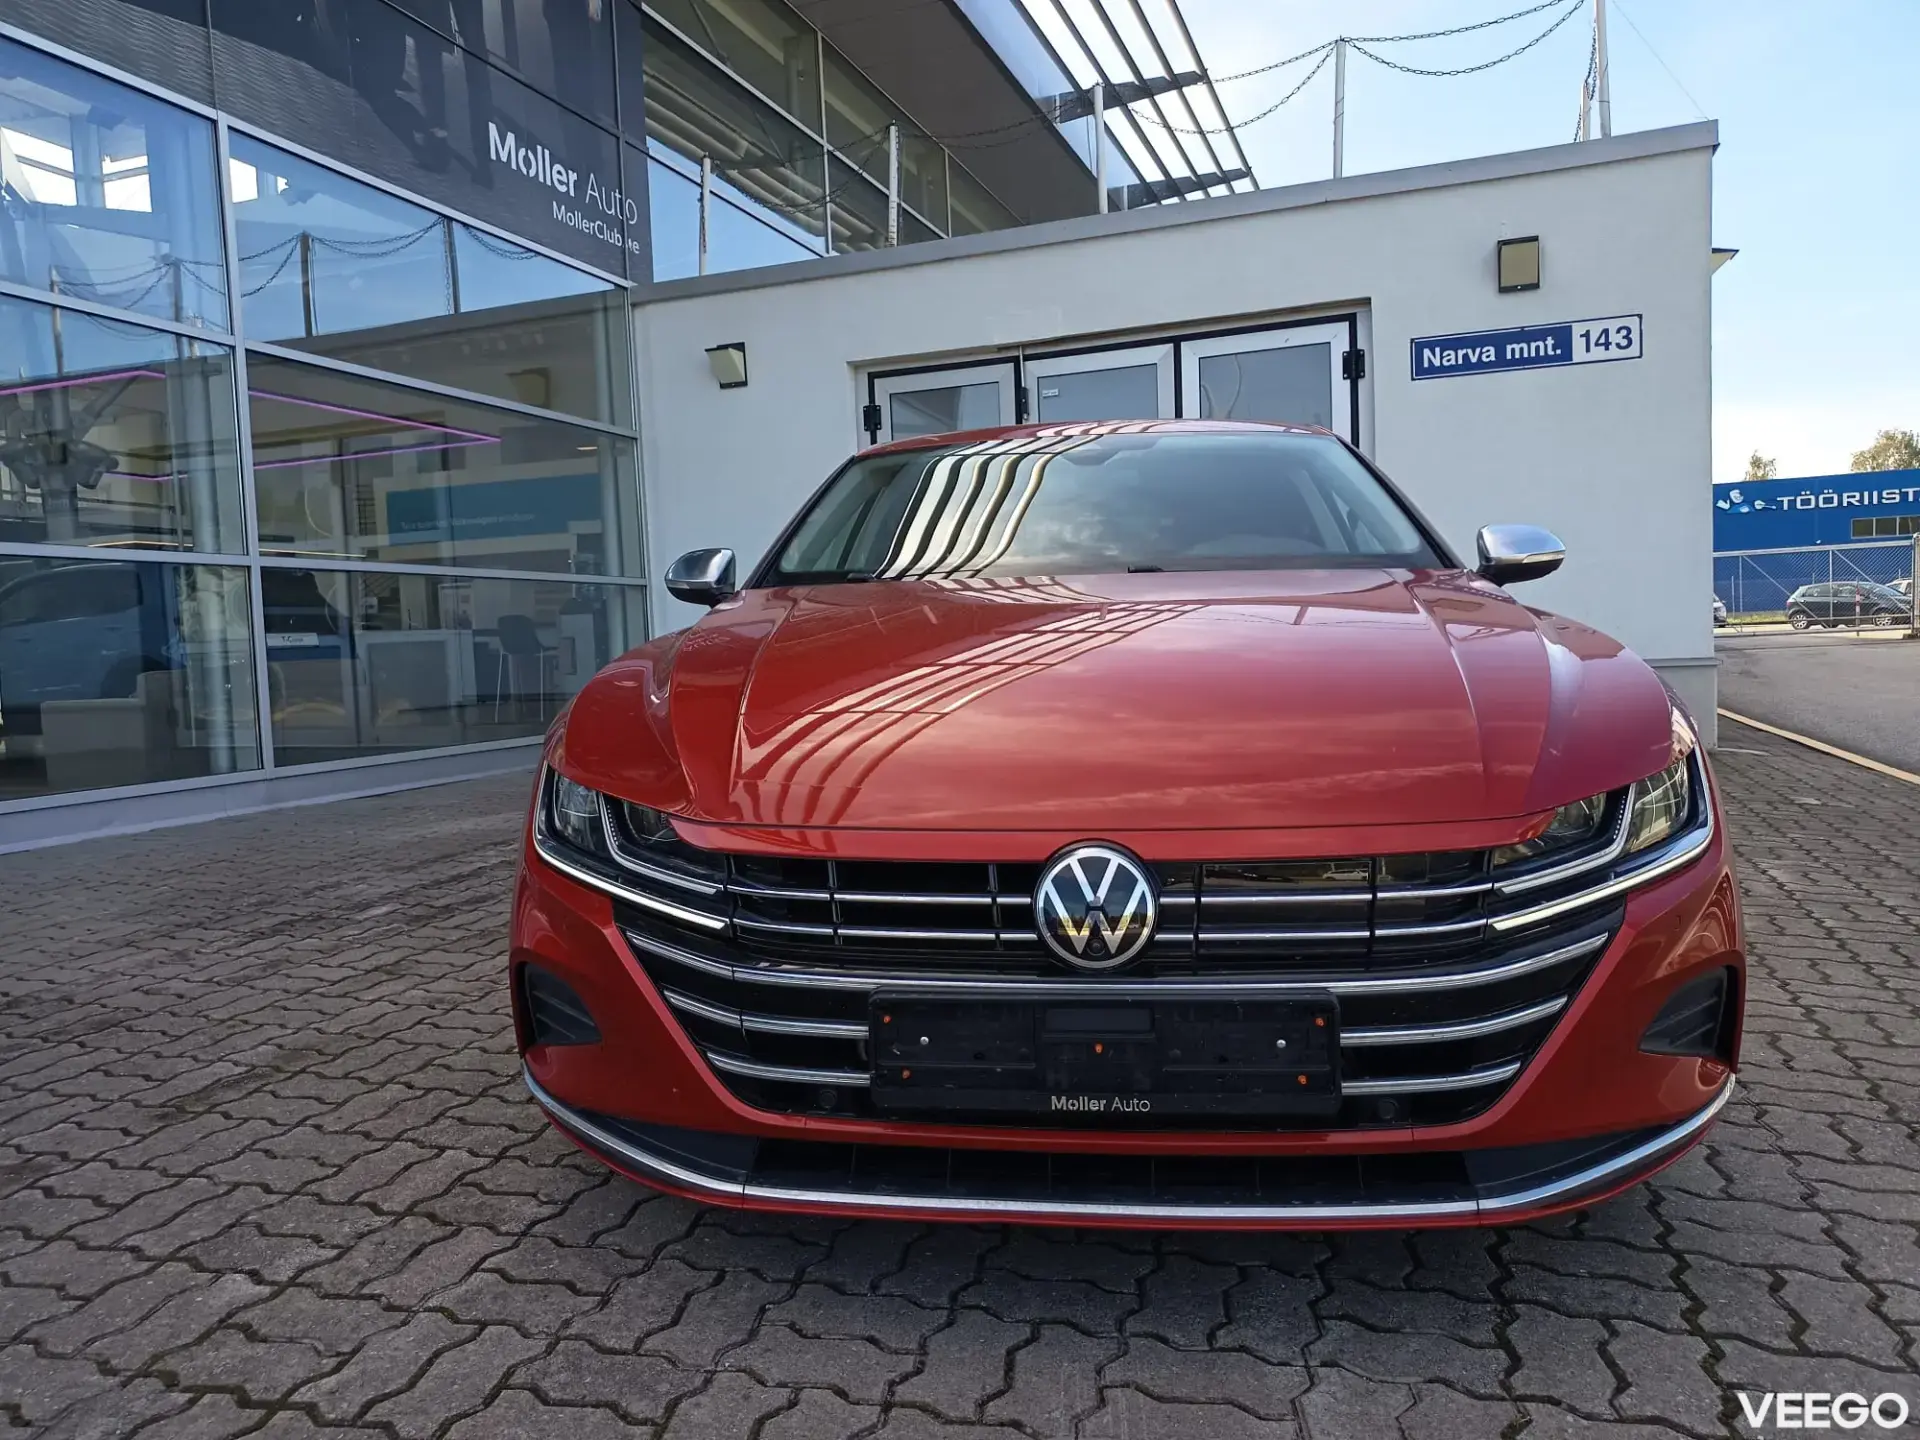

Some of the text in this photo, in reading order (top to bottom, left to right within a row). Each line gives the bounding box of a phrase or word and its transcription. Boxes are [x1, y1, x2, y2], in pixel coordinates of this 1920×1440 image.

[585, 172, 638, 225] Auto
[1422, 325, 1633, 368] Narva mnt. 143
[1777, 488, 1920, 511] TÖÖRIIST
[1111, 1096, 1151, 1112] Auto
